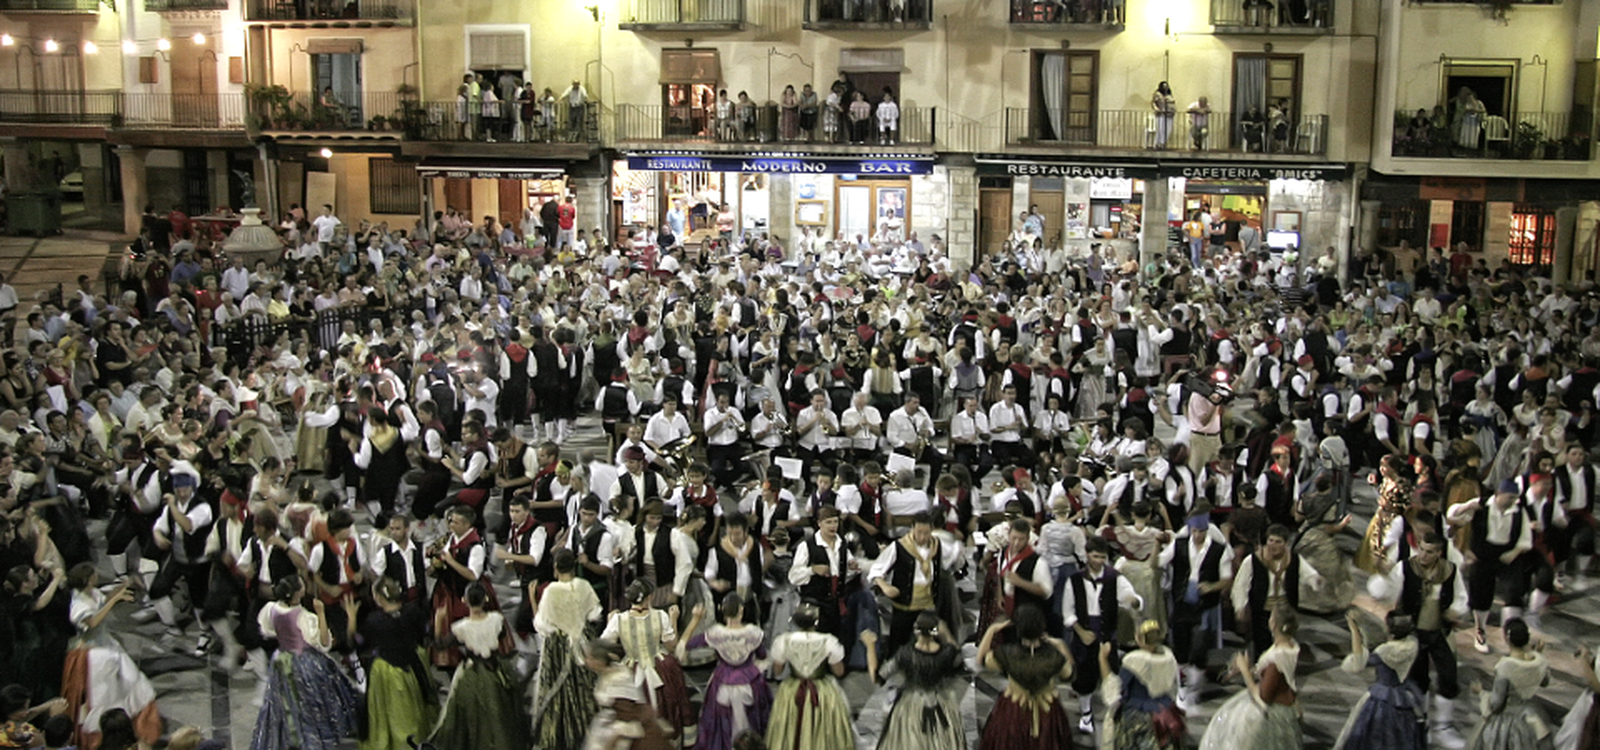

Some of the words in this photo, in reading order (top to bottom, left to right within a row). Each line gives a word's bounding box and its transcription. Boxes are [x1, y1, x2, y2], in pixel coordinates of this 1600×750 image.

[647, 159, 712, 170] RESTAURANTE
[741, 161, 826, 172] MODERNO
[859, 162, 912, 173] BAR
[1007, 164, 1125, 177] RESTAURANTE
[1182, 167, 1261, 178] CAFETERIA
